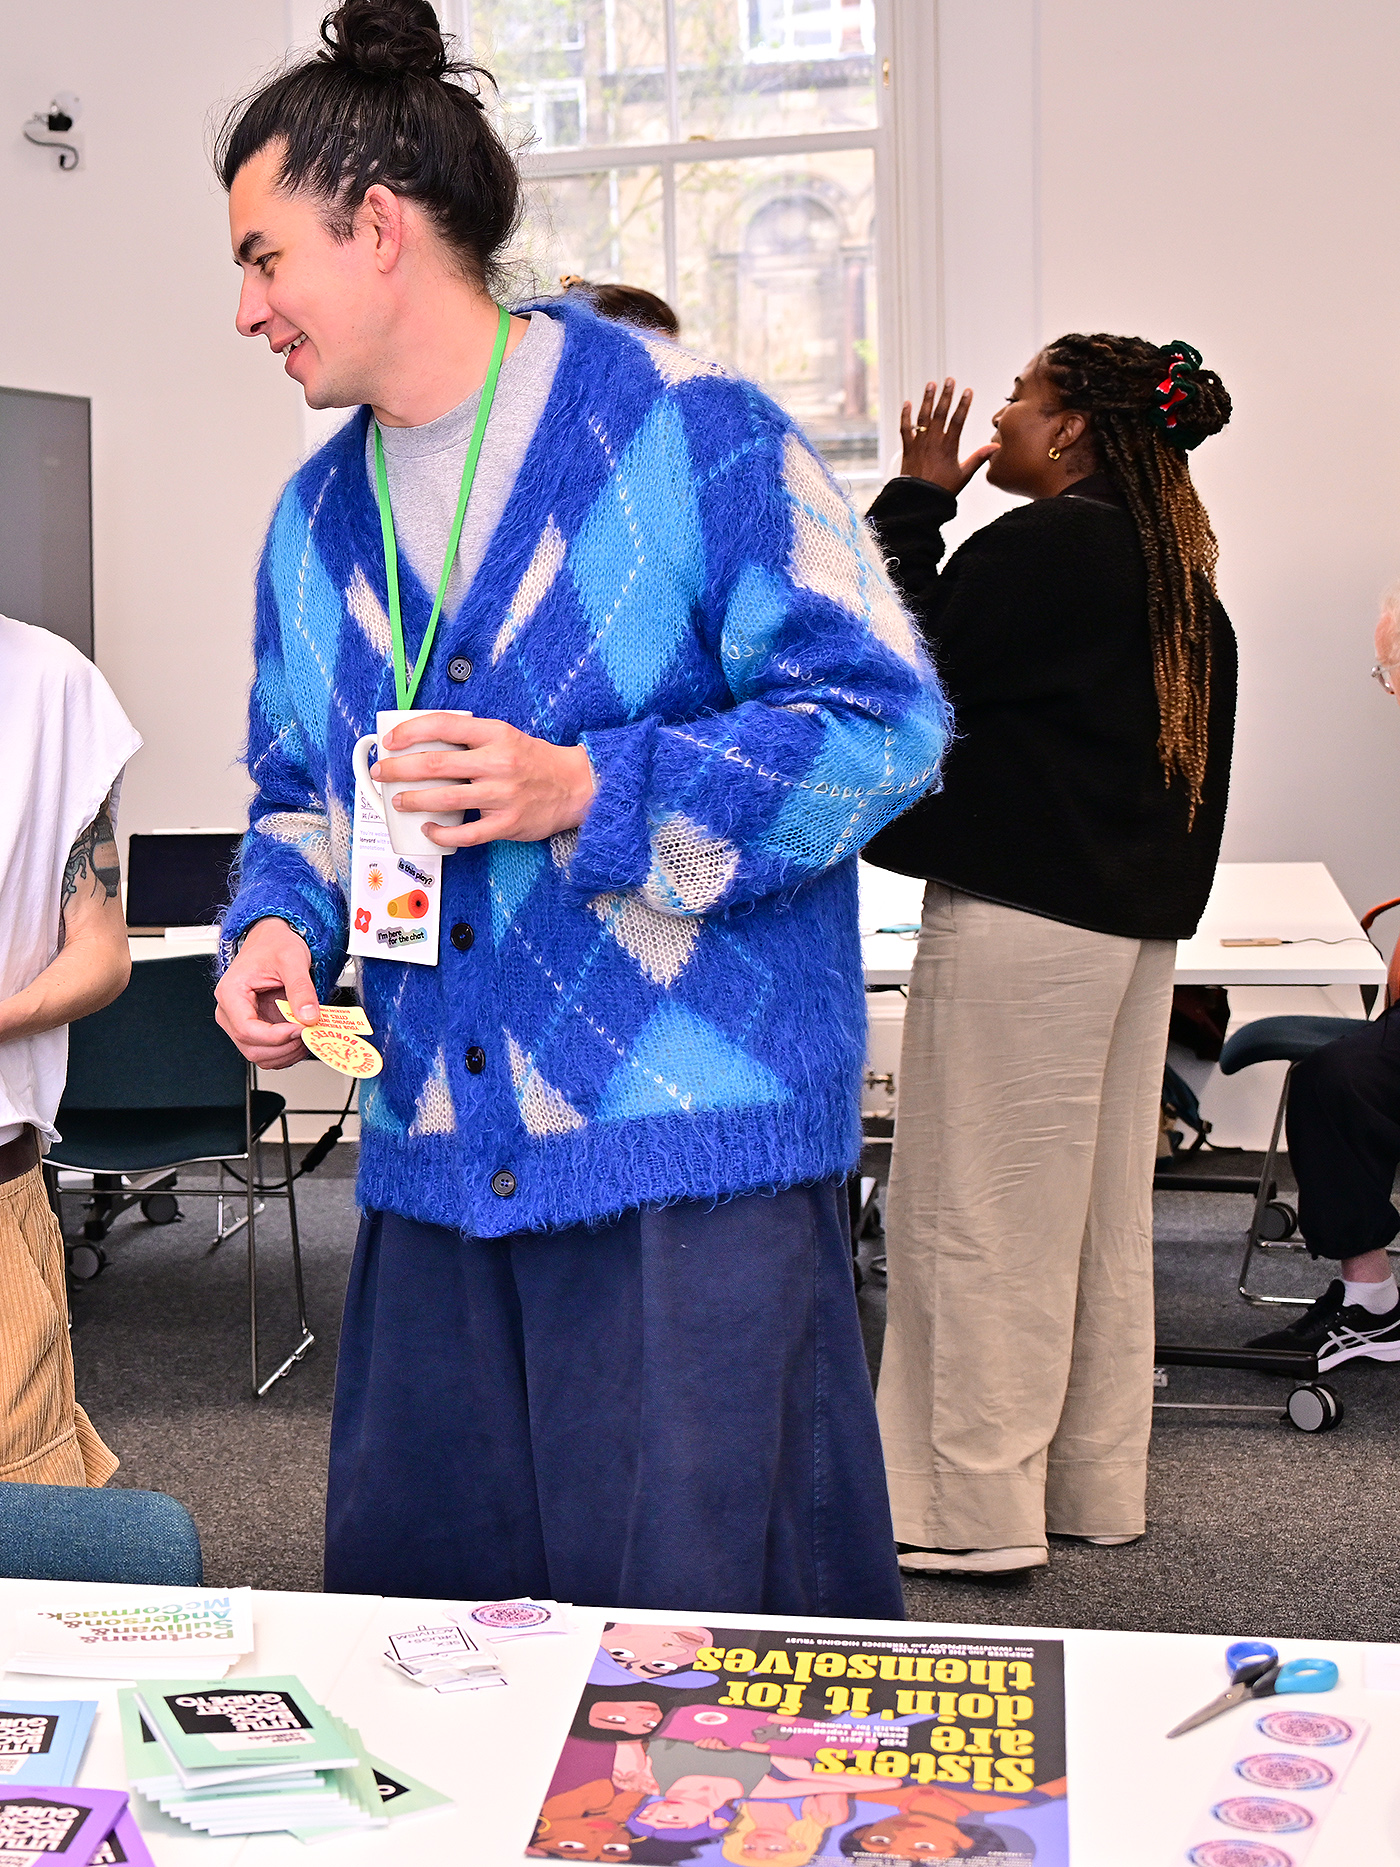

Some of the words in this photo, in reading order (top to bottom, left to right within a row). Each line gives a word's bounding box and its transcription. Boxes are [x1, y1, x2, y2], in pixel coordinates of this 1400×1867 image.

[399, 861, 404, 870] Is
[405, 864, 415, 876] this
[415, 873, 432, 885] play?
[378, 932, 388, 941] I'm
[388, 930, 402, 938] here
[388, 937, 397, 945] for
[399, 935, 409, 943] the
[410, 931, 424, 941] chat
[310, 1030, 358, 1046] BORDERS
[37, 1596, 231, 1622] McCormack.
[395, 1628, 453, 1640] ACTIVISM
[785, 1637, 815, 1645] TRUST
[816, 1639, 860, 1647] HIGGINS
[861, 1641, 909, 1649] TERRENCE
[920, 1647, 947, 1655] LOVE
[987, 1650, 1034, 1658] PREPSTER
[691, 1646, 1035, 1693] themselves
[175, 1696, 211, 1708] TO
[208, 1693, 283, 1706] GUIDE
[717, 1681, 807, 1716] for
[824, 1685, 871, 1719] it
[196, 1701, 290, 1716] POCKET
[880, 1688, 1034, 1728] doin'
[225, 1710, 297, 1723] BACK
[231, 1719, 302, 1732] LITTLE
[779, 1726, 849, 1736] reproductive
[813, 1721, 853, 1730] women
[825, 1735, 839, 1743] of
[839, 1735, 864, 1743] part
[879, 1738, 908, 1748] PrEP
[929, 1725, 1035, 1757] are
[811, 1746, 1035, 1794] Sisters
[2, 1805, 79, 1819] GUIDE
